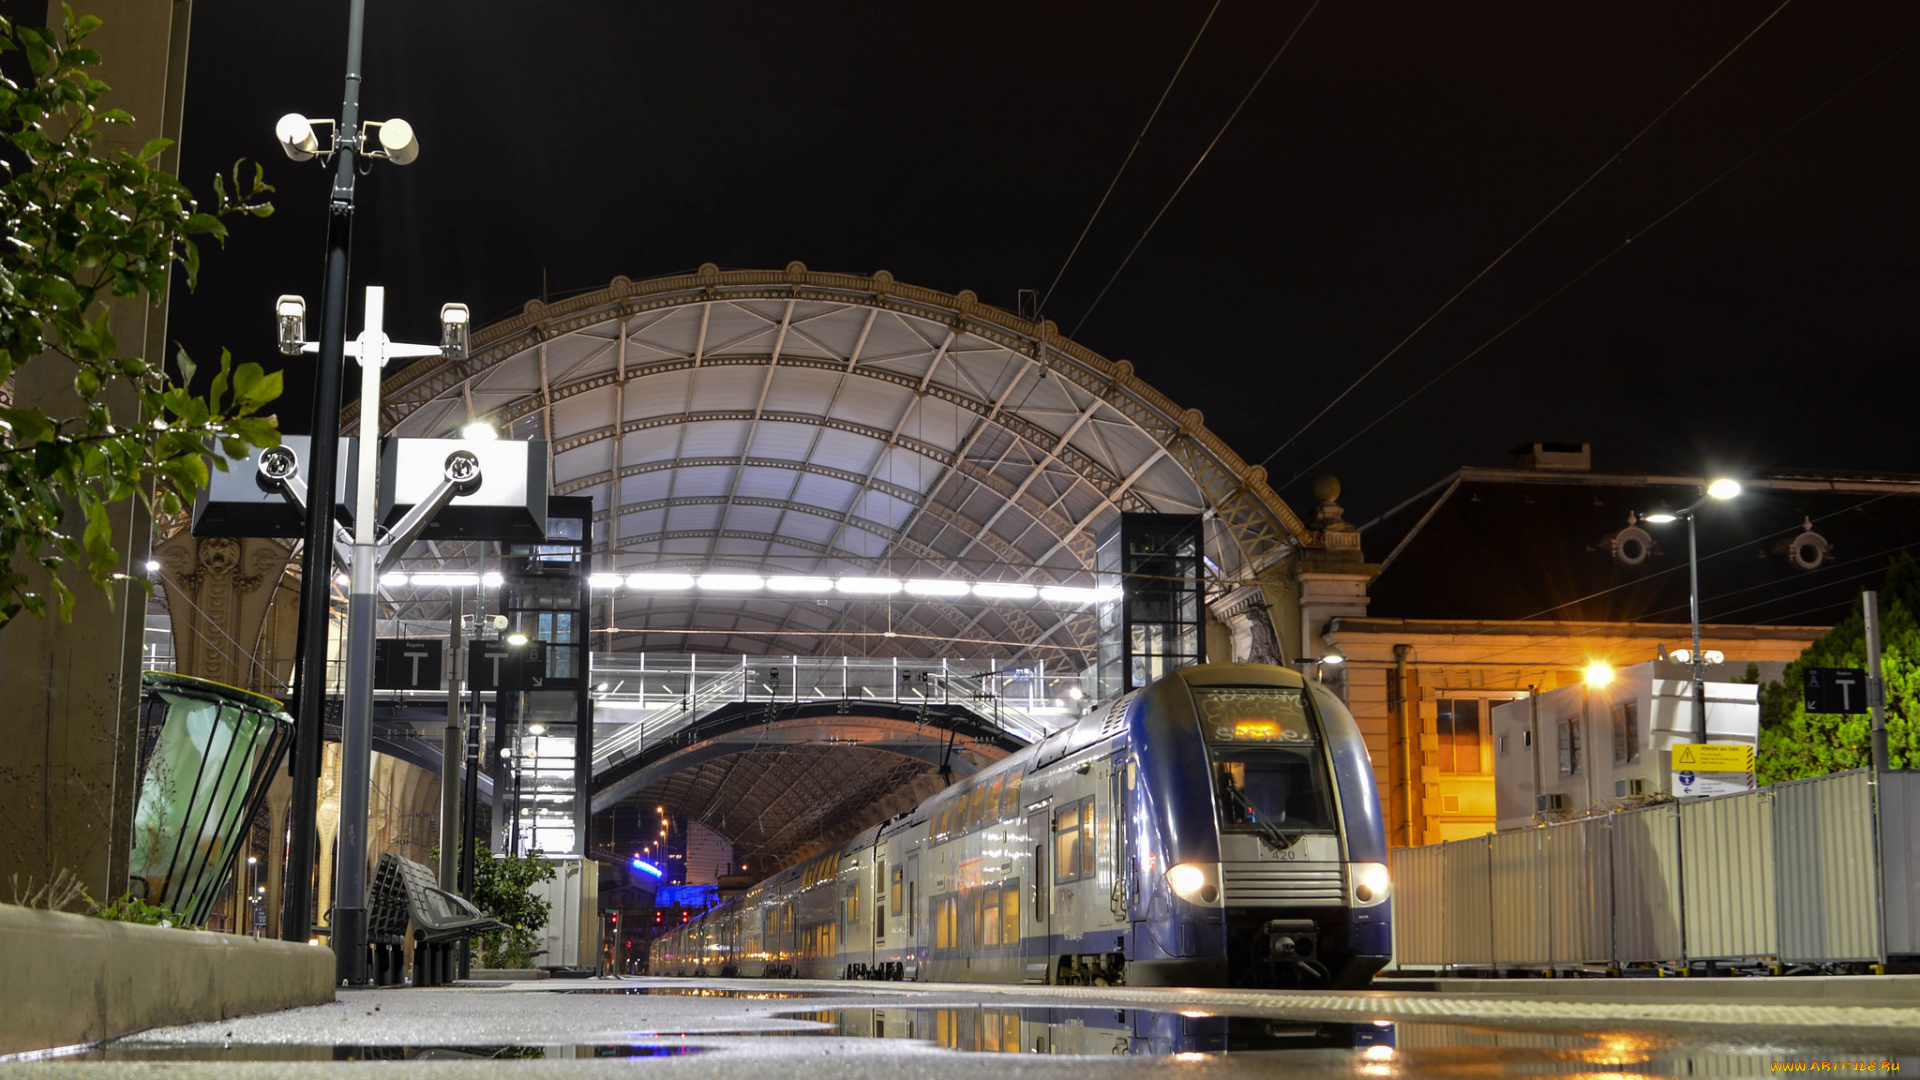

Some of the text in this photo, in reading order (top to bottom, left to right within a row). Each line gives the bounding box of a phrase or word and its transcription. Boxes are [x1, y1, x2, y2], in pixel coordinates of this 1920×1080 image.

[404, 652, 428, 686] T
[484, 653, 509, 687] T
[1809, 675, 1818, 685] A
[1835, 679, 1856, 710] T
[1272, 851, 1295, 860] 420
